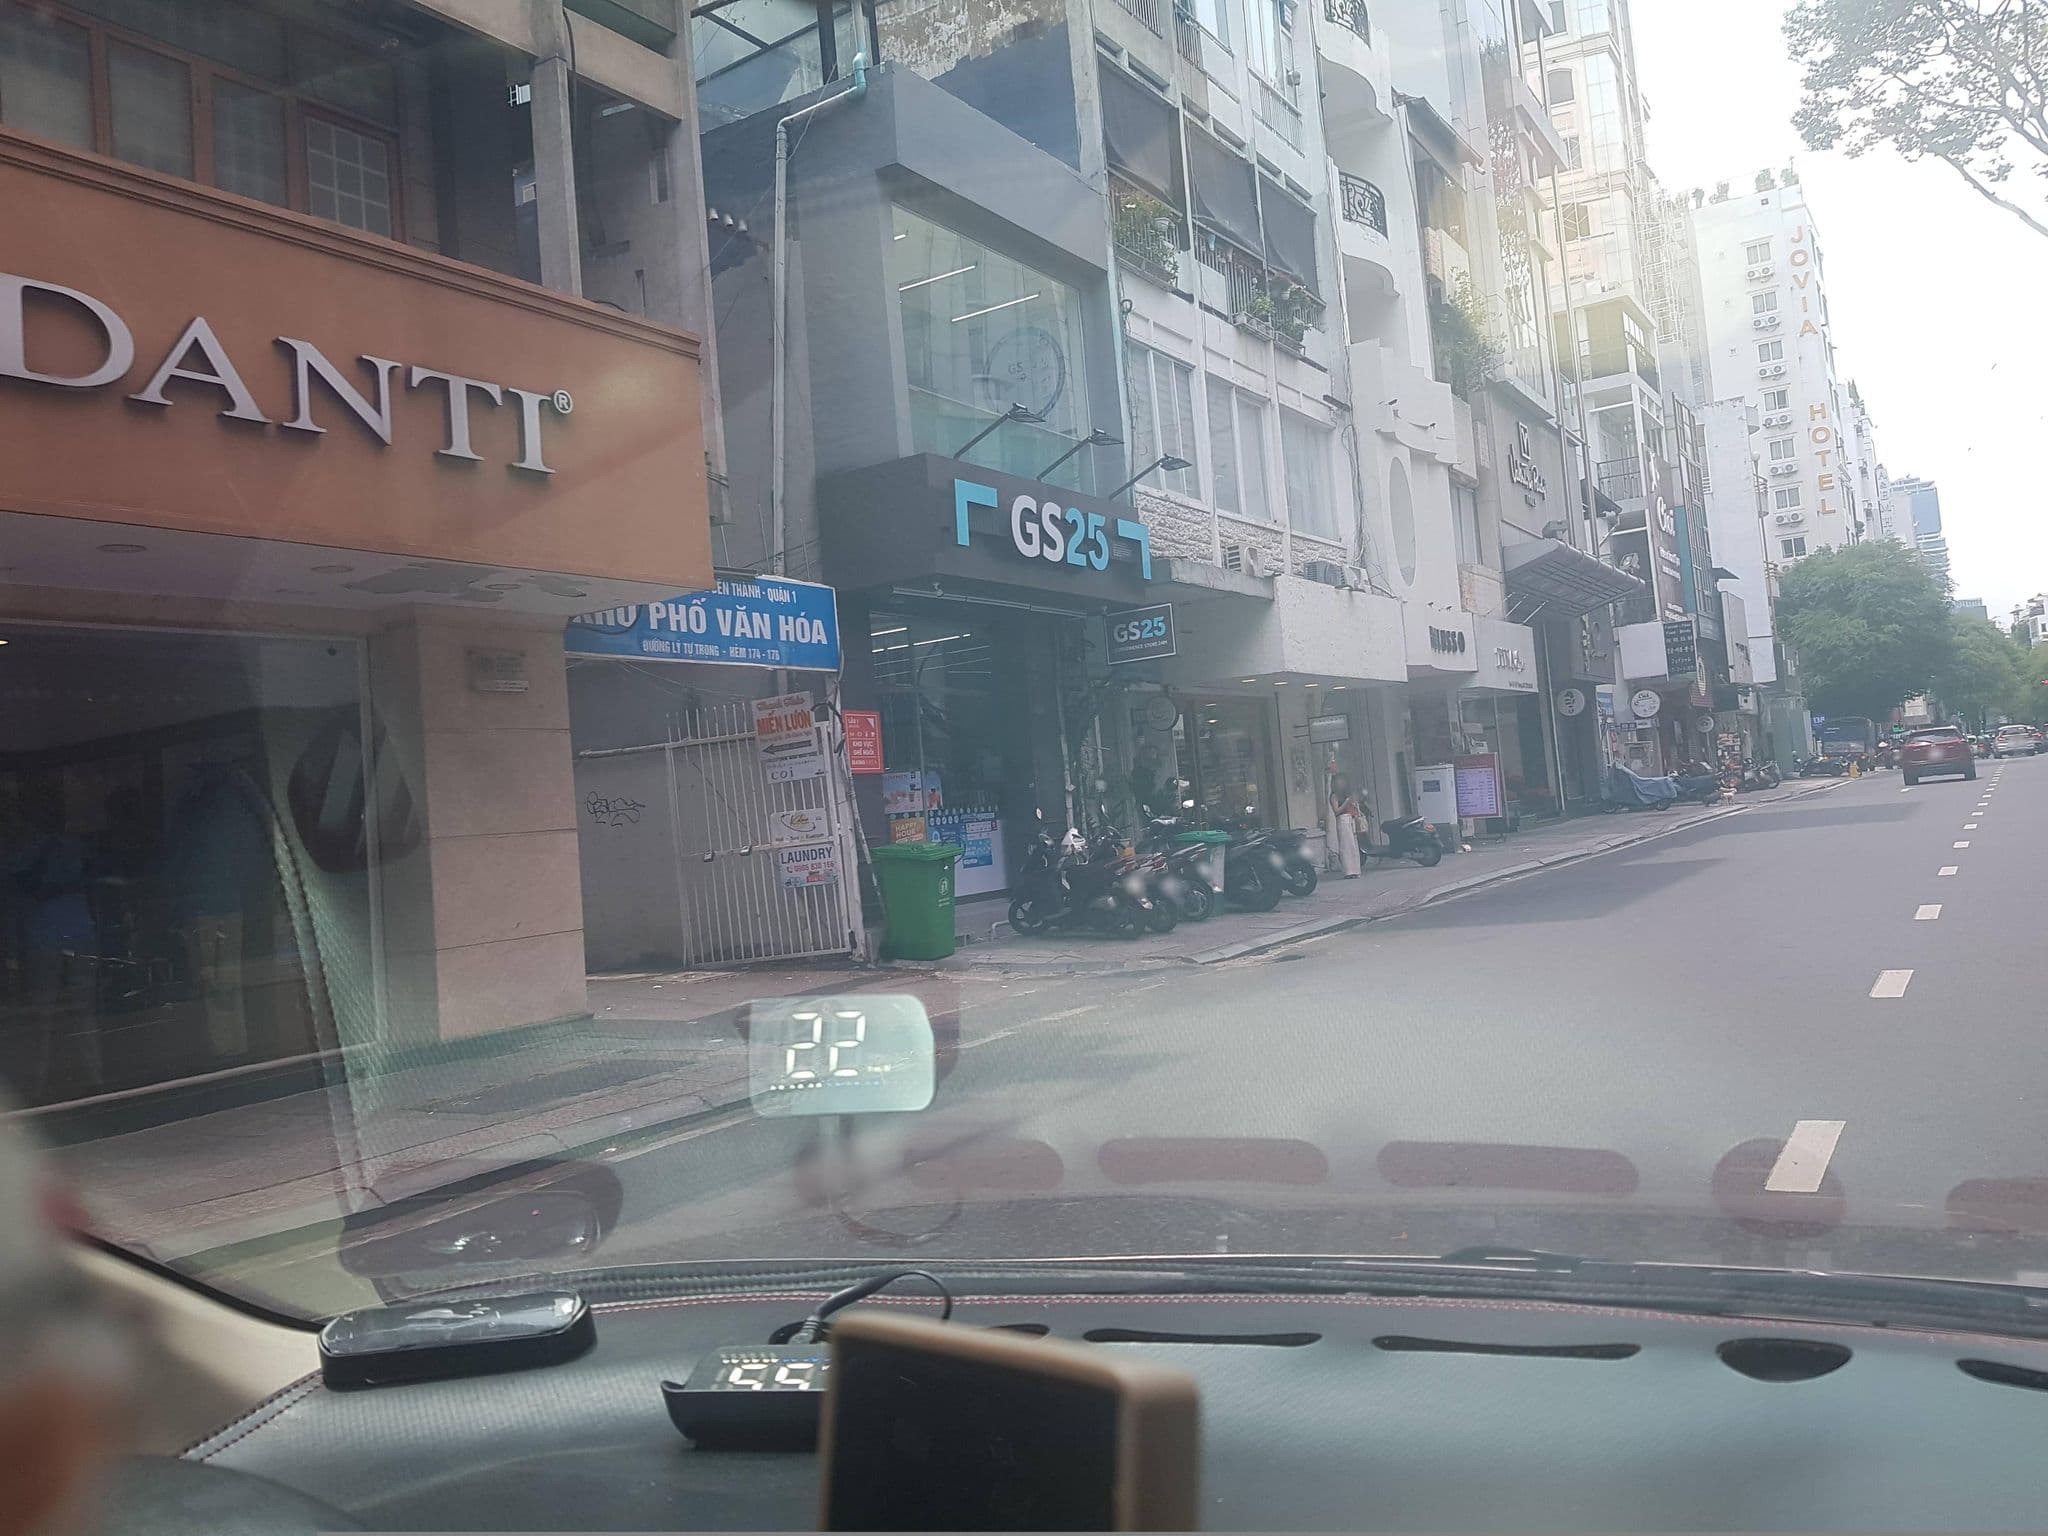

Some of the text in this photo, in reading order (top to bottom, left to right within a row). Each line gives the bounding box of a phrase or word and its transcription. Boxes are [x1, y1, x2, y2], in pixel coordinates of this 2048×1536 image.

[1789, 225, 1818, 338] JOVIA
[1807, 402, 1836, 516] HOTEL
[1011, 494, 1110, 571] GS25
[649, 598, 707, 634] PHỐ
[716, 604, 771, 641] VĂN
[778, 611, 828, 645] HÓA
[767, 587, 791, 605] QUẬN
[791, 590, 797, 604] 1
[1113, 616, 1166, 643] GS25
[780, 846, 833, 865] LAUNDRY
[786, 1010, 866, 1079] 22
